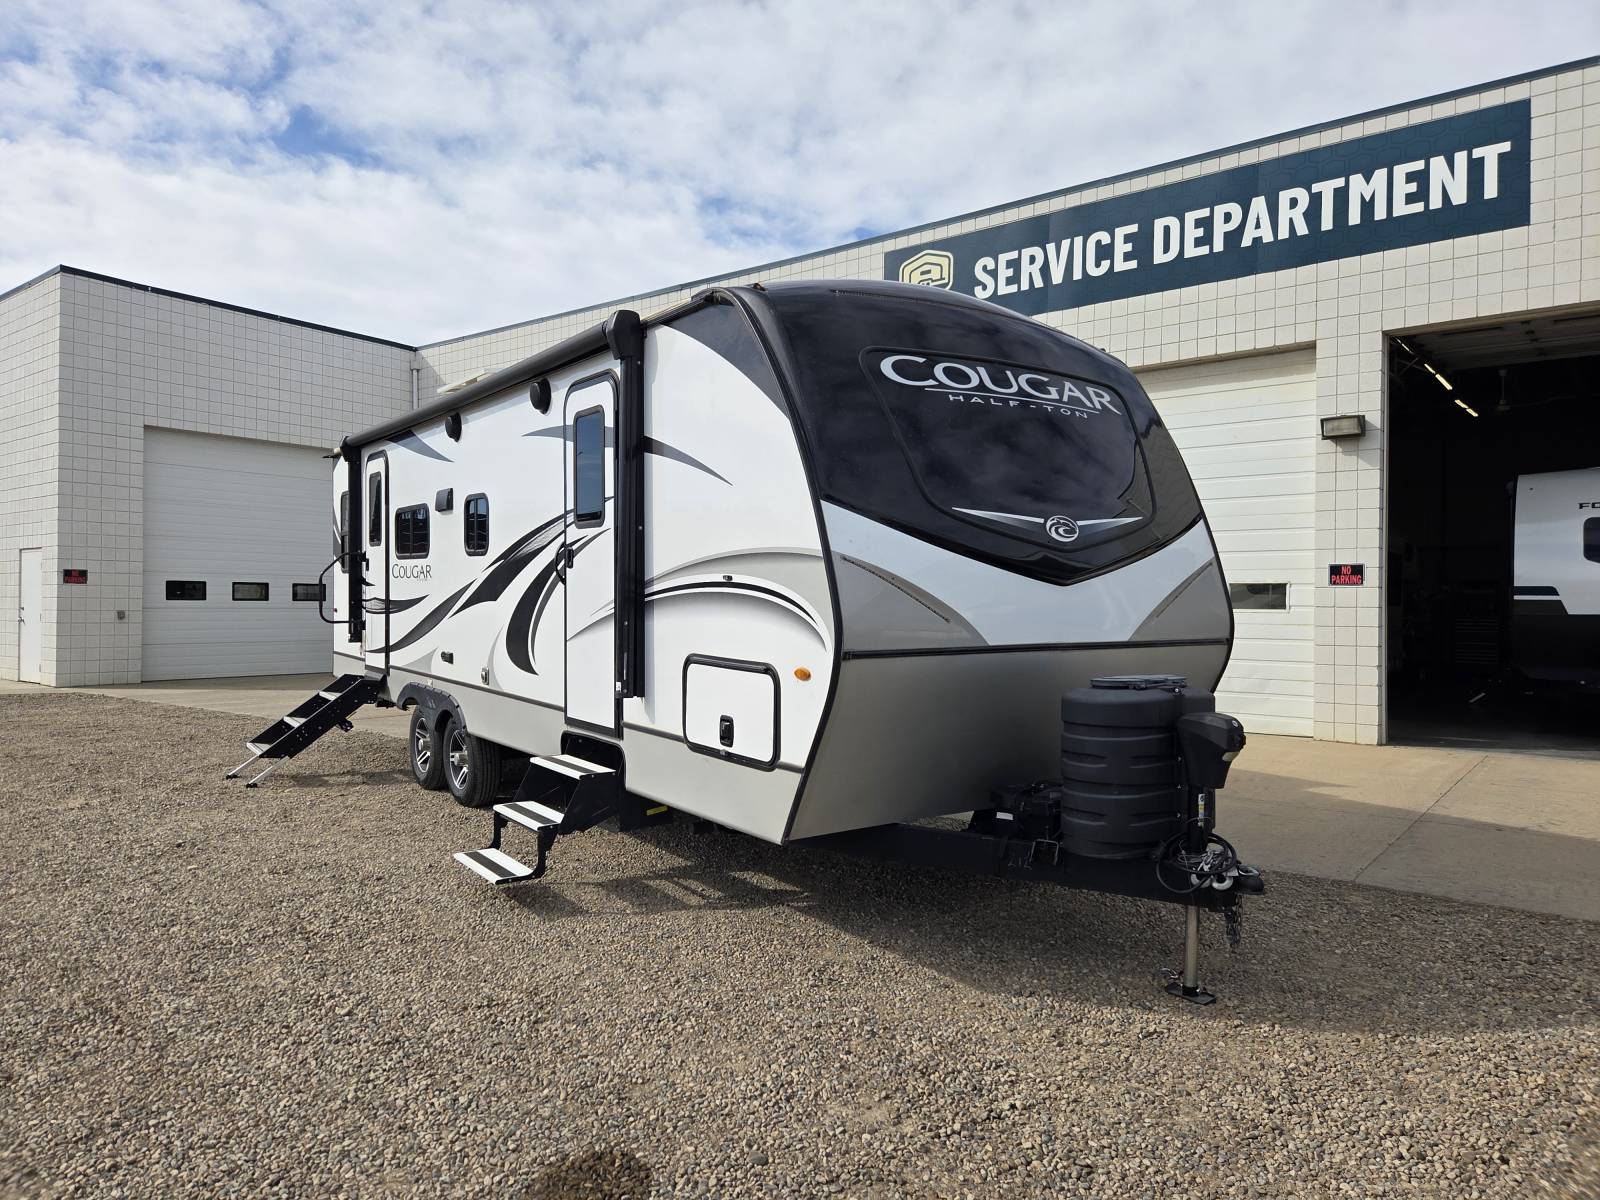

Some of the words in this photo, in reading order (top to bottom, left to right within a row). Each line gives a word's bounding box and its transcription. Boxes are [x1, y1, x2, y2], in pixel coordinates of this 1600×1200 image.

[974, 224, 1139, 300] SERVICE
[1153, 141, 1512, 265] DEPARTMENT
[879, 355, 1122, 416] COUGAR
[391, 563, 432, 579] COUGAR
[1341, 565, 1352, 575] NO
[1331, 575, 1362, 585] PARKING
